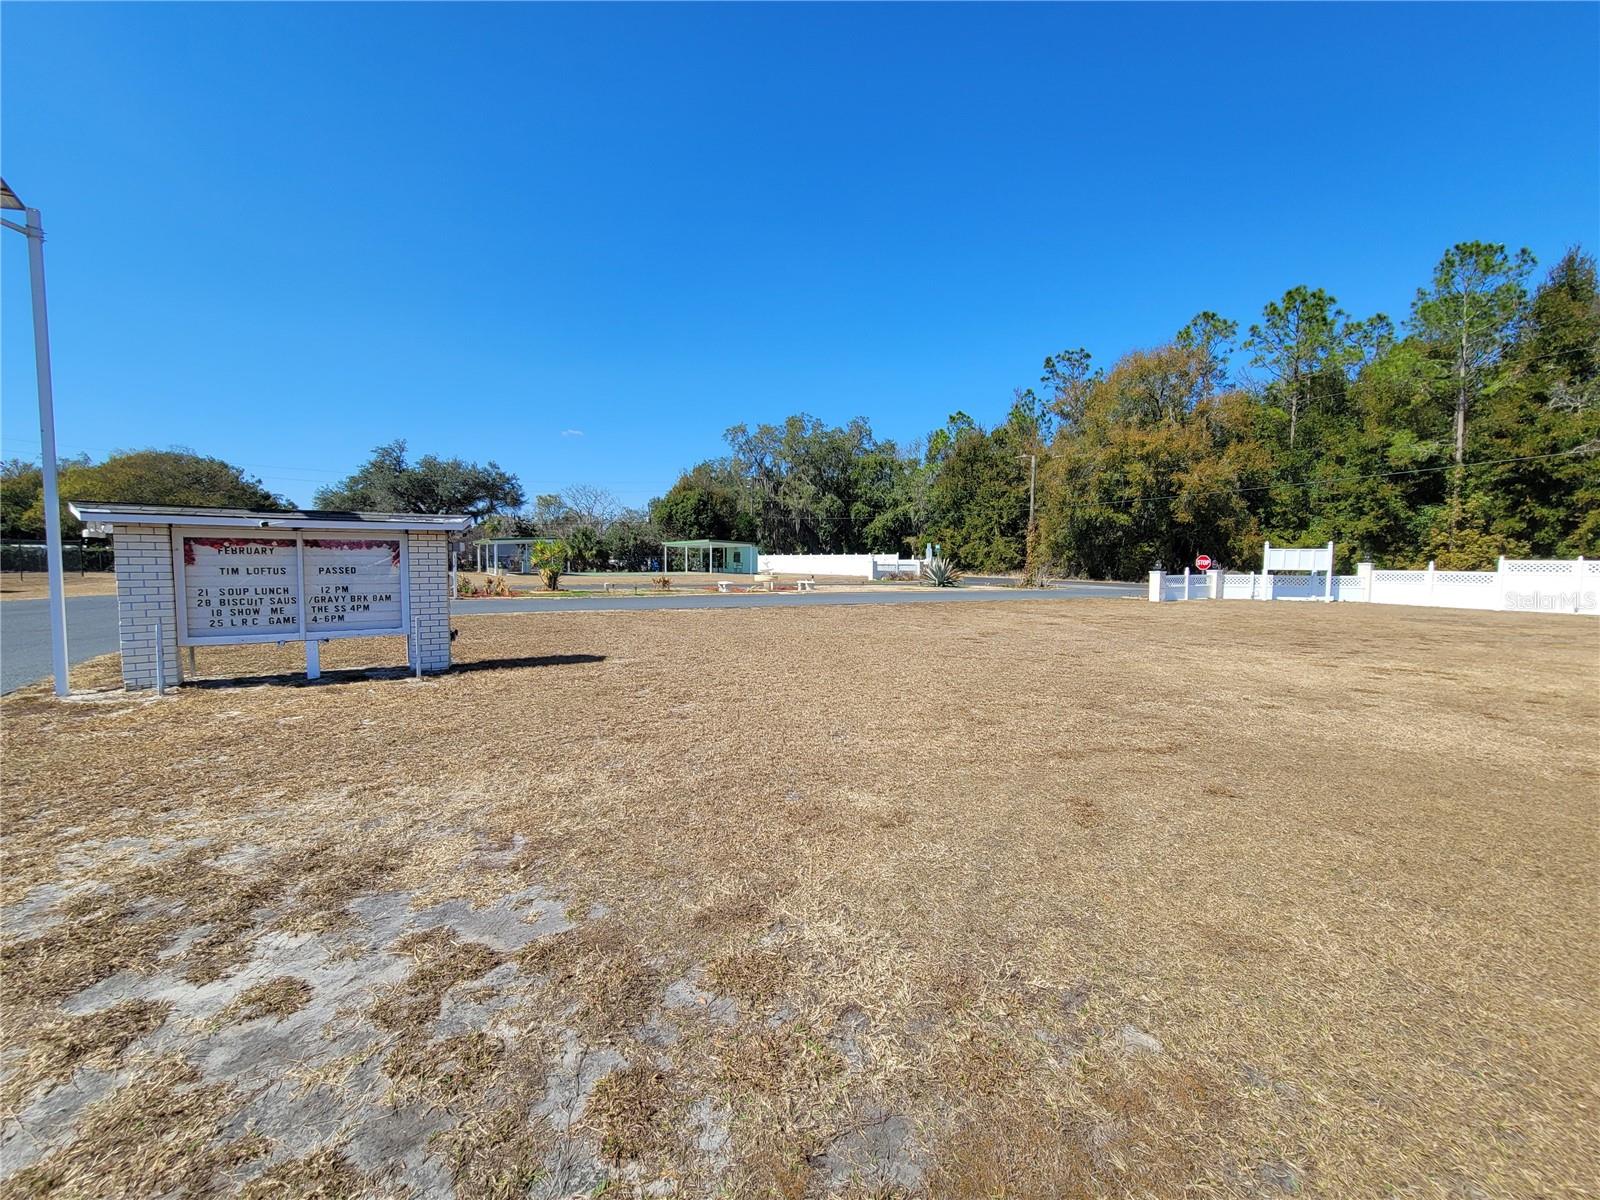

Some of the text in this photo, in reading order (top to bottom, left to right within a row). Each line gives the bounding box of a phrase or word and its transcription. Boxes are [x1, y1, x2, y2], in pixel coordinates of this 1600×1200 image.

[217, 547, 275, 555] FEBRUARY
[219, 566, 357, 575] TIM LOFTUS PASSED
[197, 585, 349, 597] 21 SOUP LUNCH 12 PM
[219, 598, 264, 607] BISCUIT
[269, 597, 297, 605] SAUS
[350, 594, 368, 603] BRK
[211, 603, 370, 617] 18 SHOW ME THE SS 4PM
[209, 619, 224, 628] 25
[268, 616, 297, 625] GAME
[311, 614, 345, 623] 4-6PM
